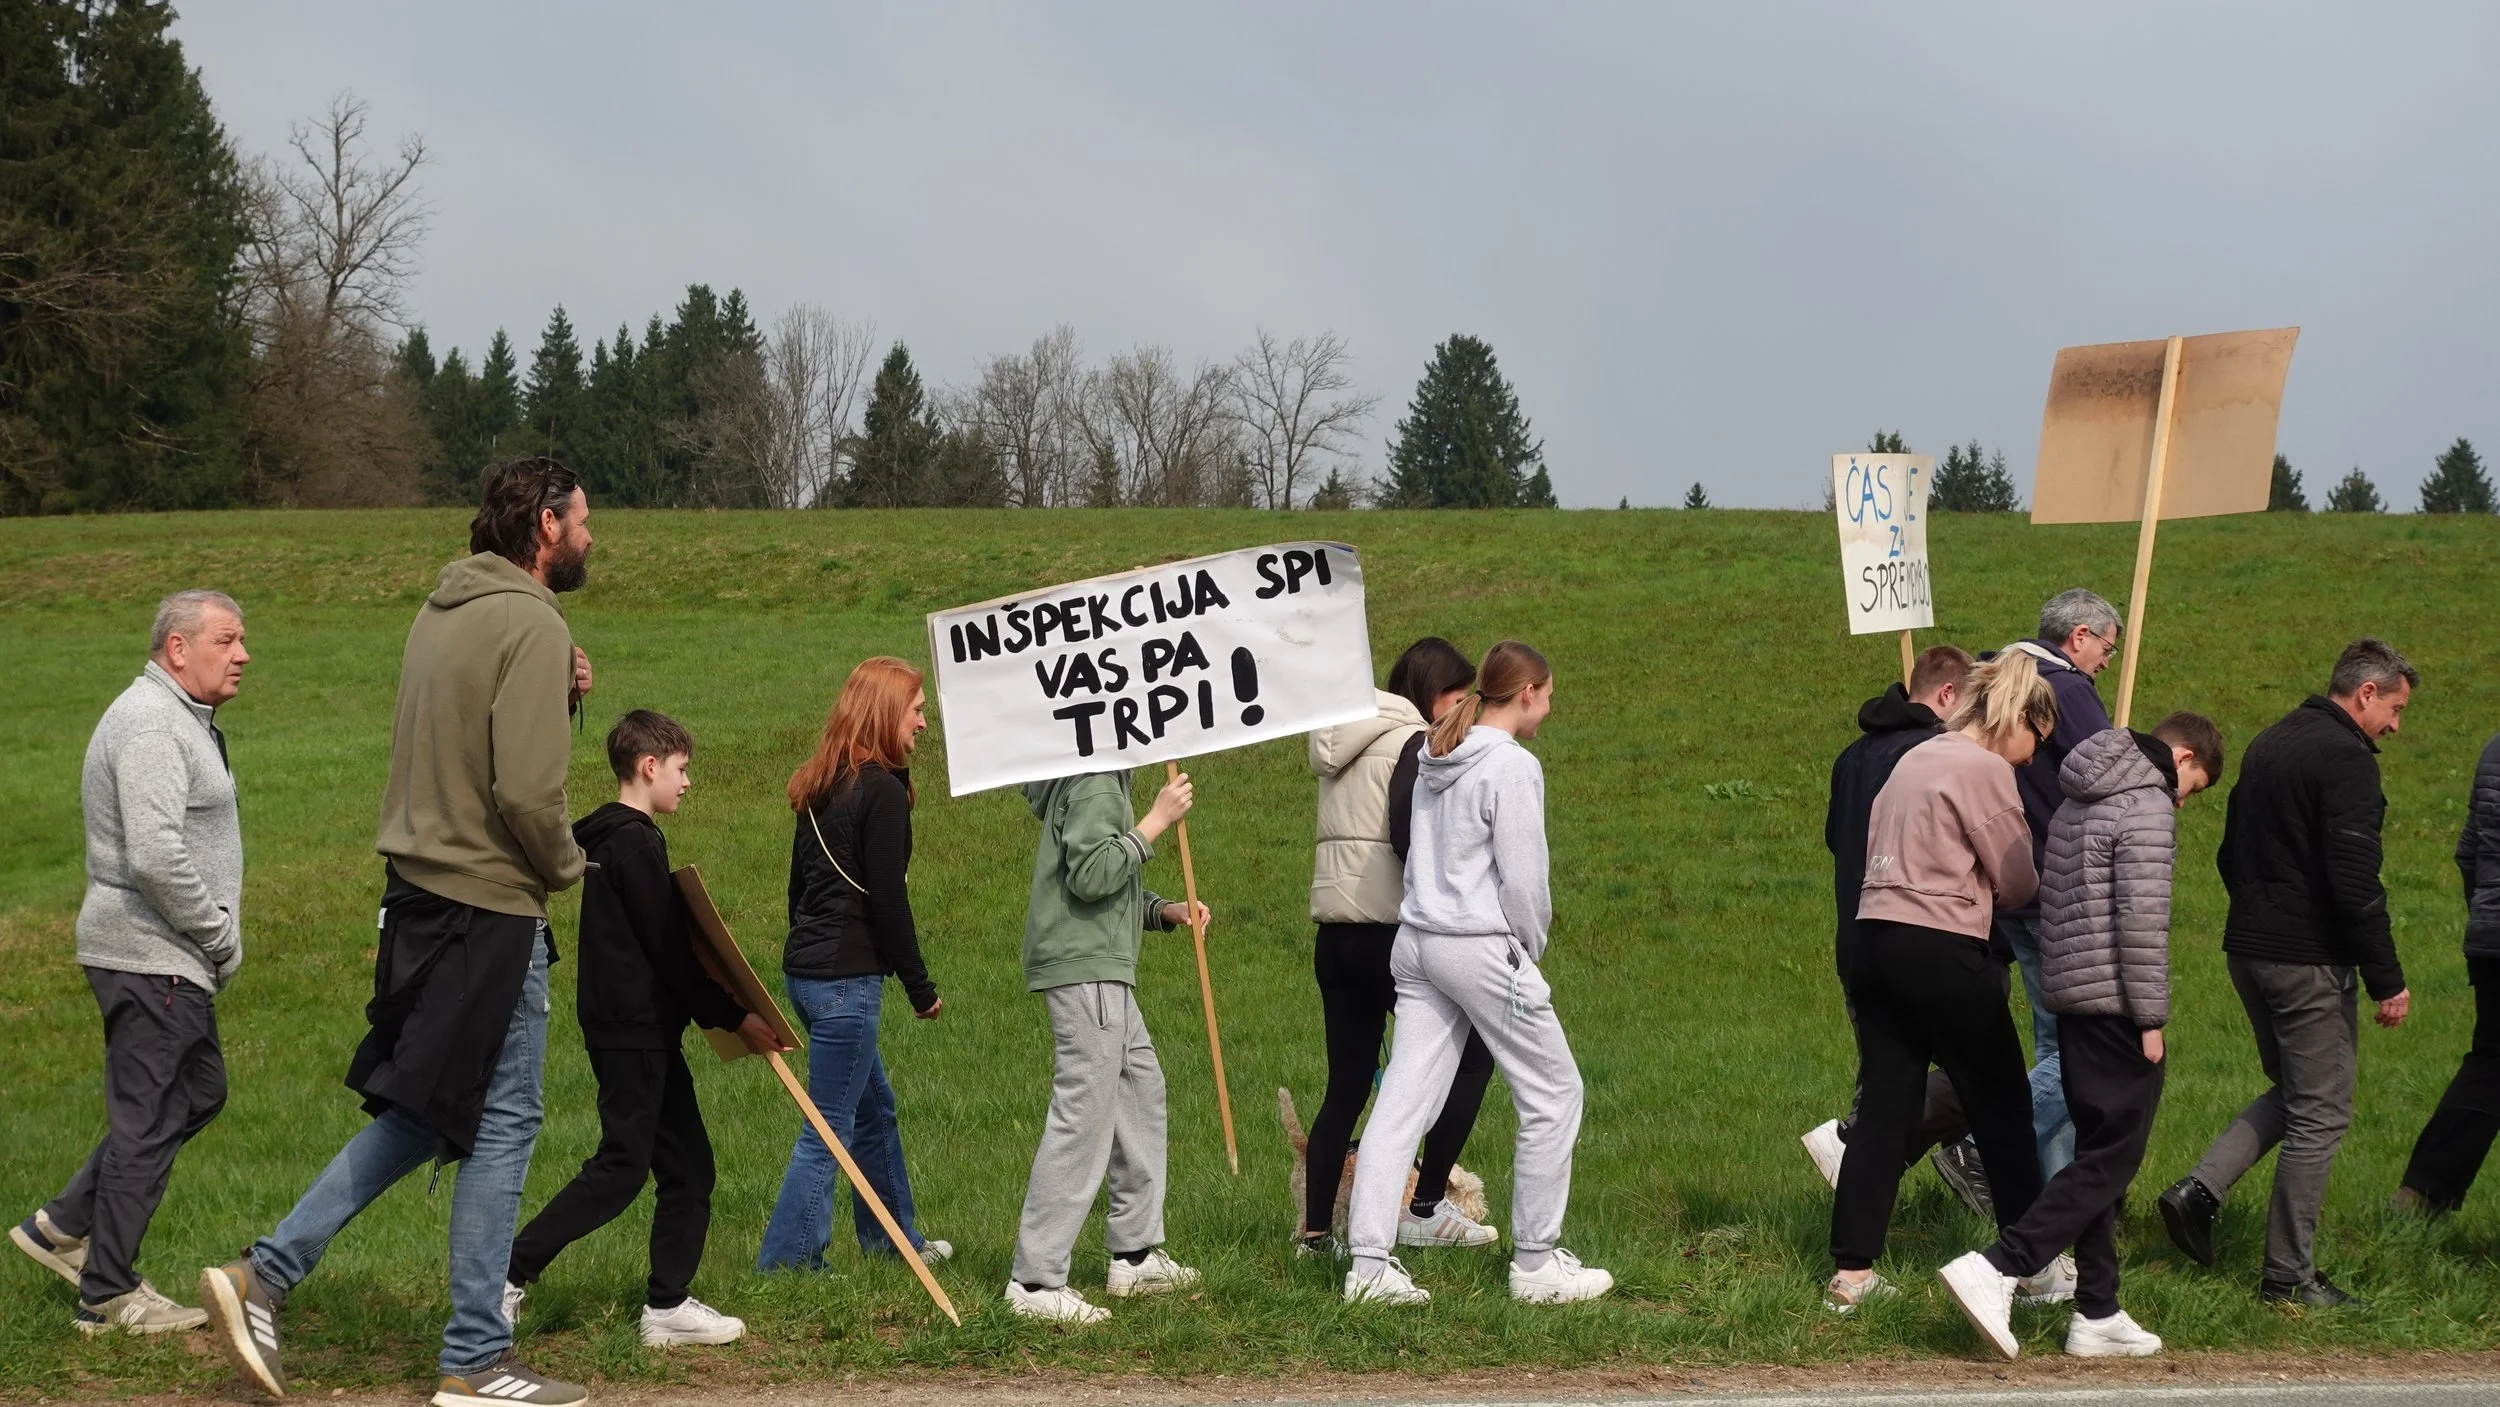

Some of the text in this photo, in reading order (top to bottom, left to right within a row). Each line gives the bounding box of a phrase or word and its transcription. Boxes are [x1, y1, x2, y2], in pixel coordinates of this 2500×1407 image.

[1846, 456, 1918, 528] ČAS JE
[1889, 525, 1906, 558] ZA
[950, 548, 1332, 663] INŠPEKCIJA SPI
[1035, 630, 1210, 699] VAS PA
